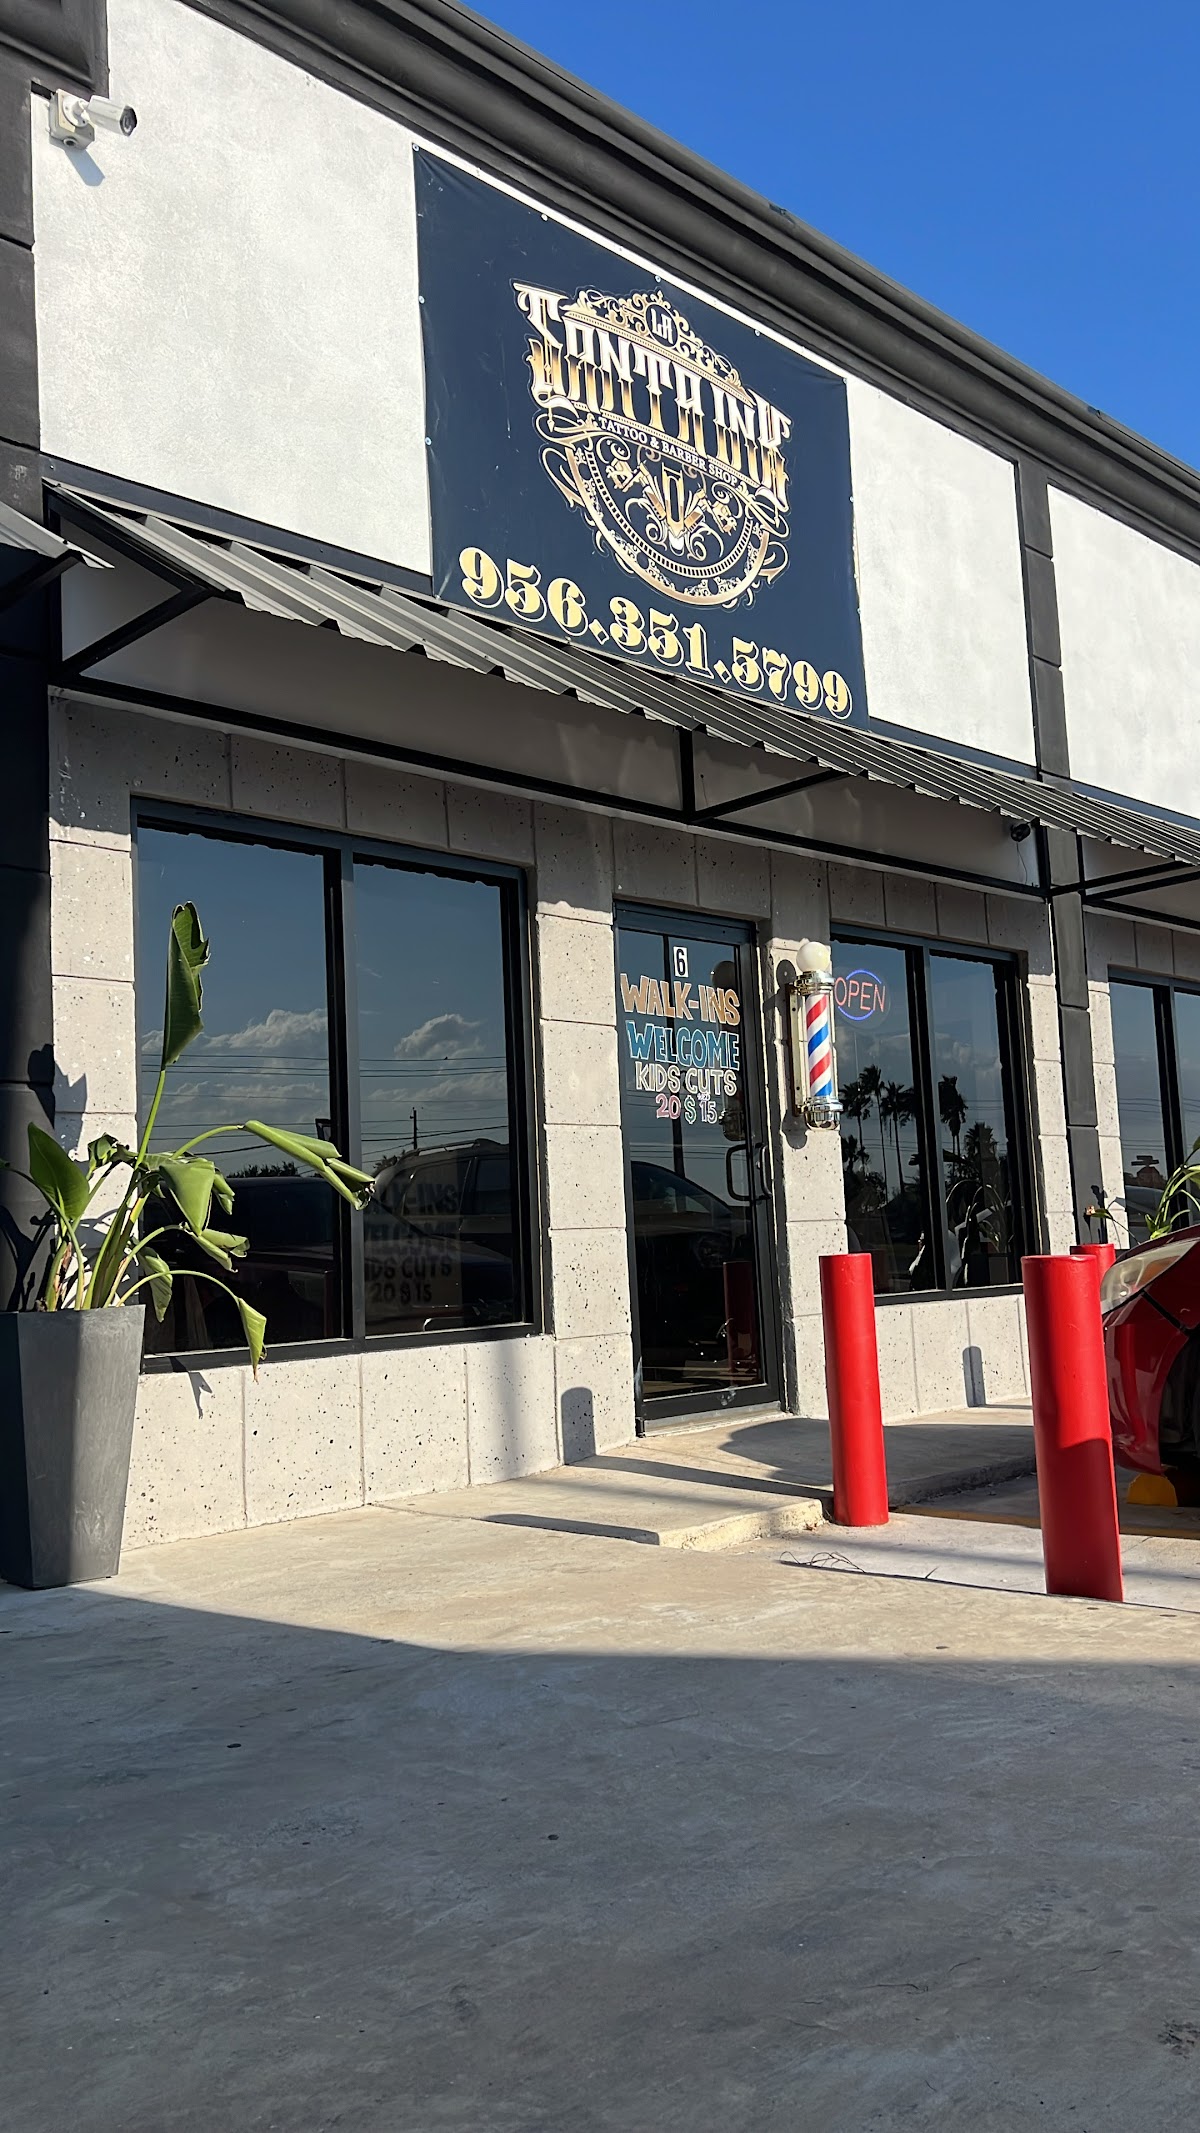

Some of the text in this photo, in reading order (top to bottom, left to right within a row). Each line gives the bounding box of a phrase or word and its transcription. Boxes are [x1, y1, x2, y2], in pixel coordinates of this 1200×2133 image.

[651, 308, 676, 345] LA
[599, 416, 738, 487] TATTOO & BARBER SHOP
[459, 546, 853, 720] 956.351.5799
[674, 950, 686, 976] 6
[620, 973, 741, 1026] WALK-INS
[834, 976, 886, 1012] OPEN
[625, 1020, 740, 1070] WELCOME
[635, 1061, 737, 1096] KIDS CUTS
[655, 1093, 718, 1125] 20 $ 15
